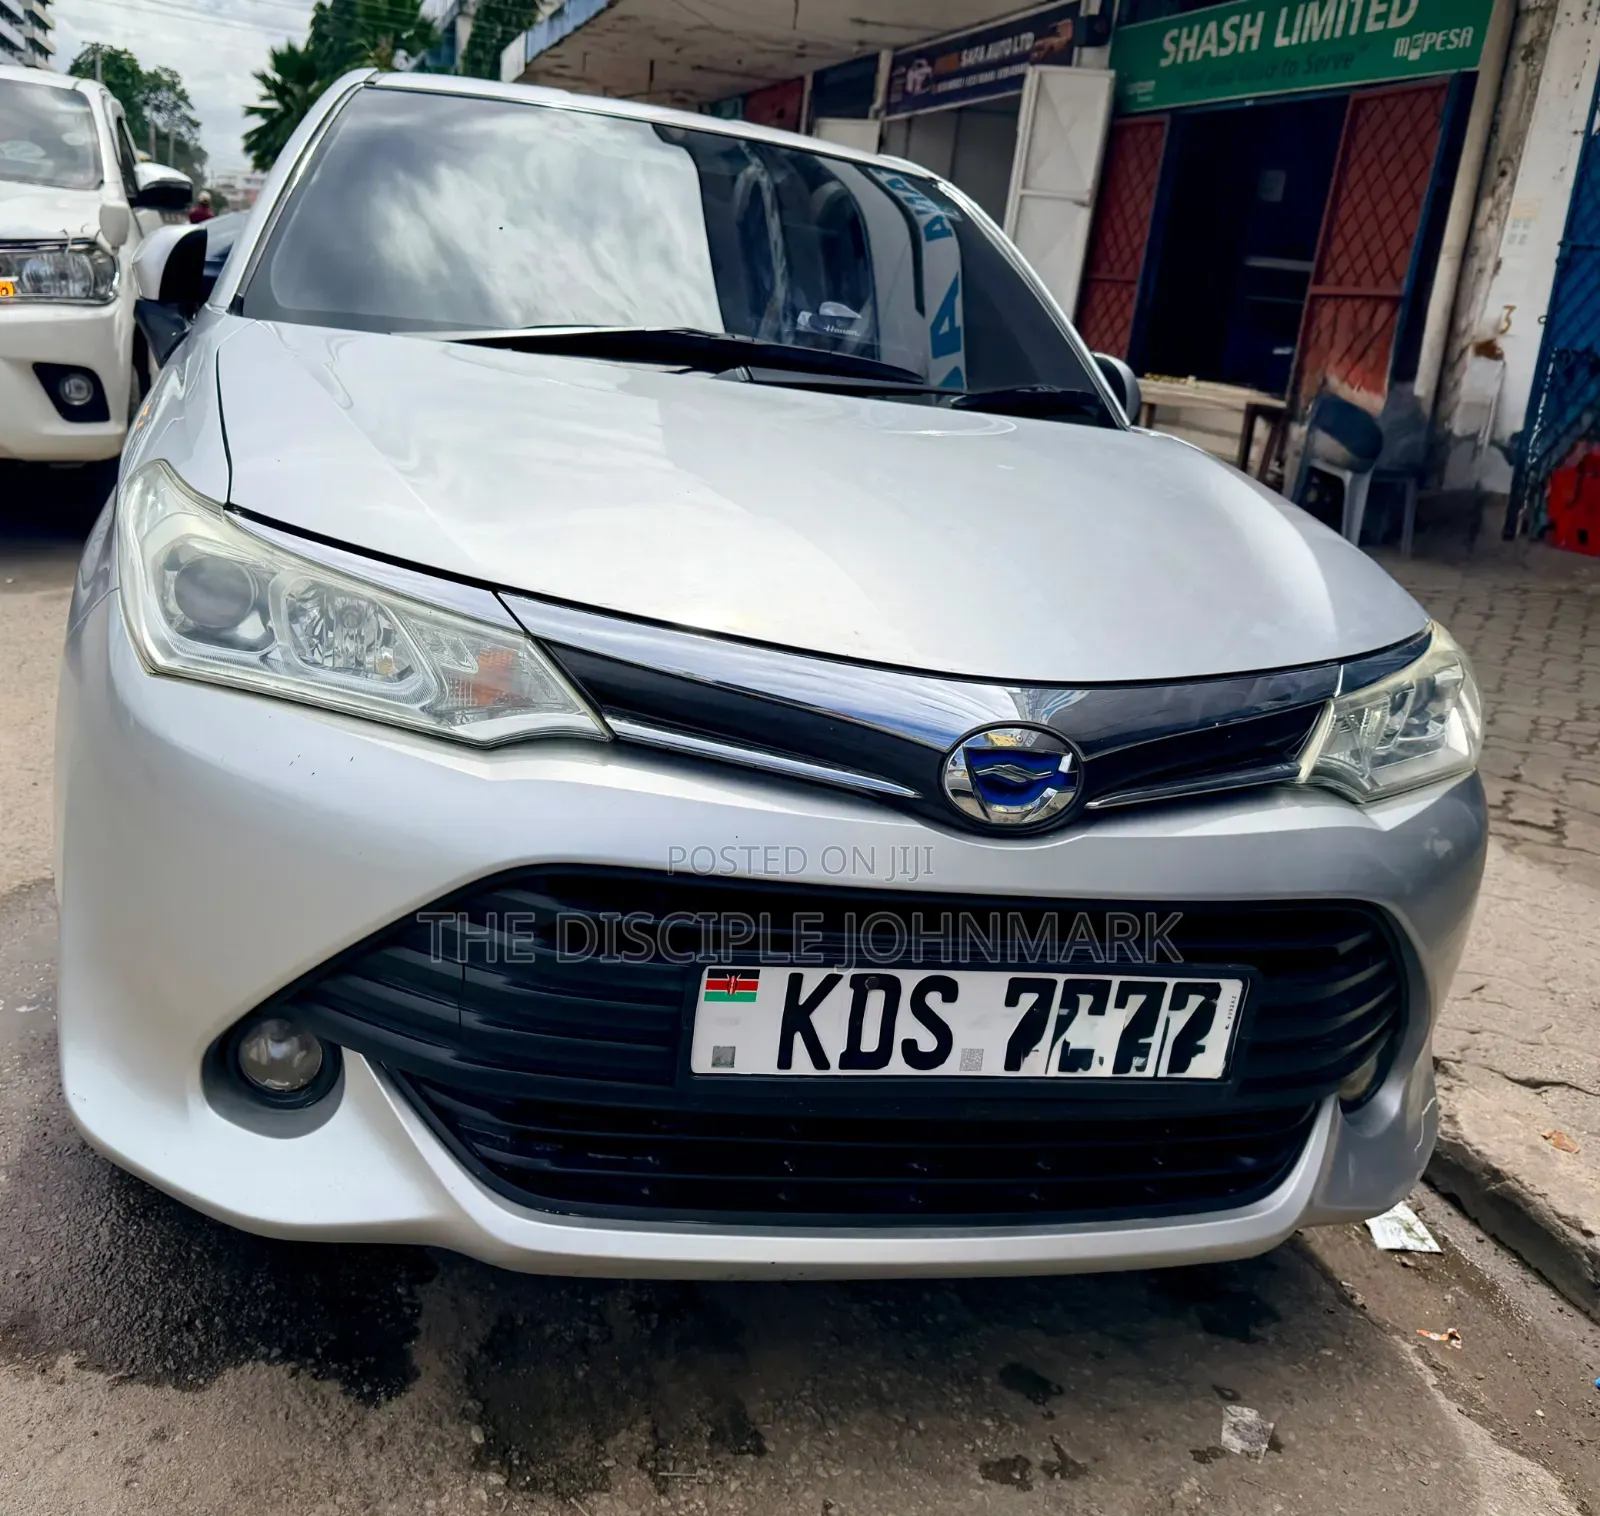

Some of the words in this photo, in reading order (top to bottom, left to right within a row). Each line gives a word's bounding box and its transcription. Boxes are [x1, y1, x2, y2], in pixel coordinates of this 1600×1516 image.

[1160, 11, 1265, 68] SHASH
[1274, 0, 1420, 48] LIMITED
[777, 972, 959, 1070] KDS
